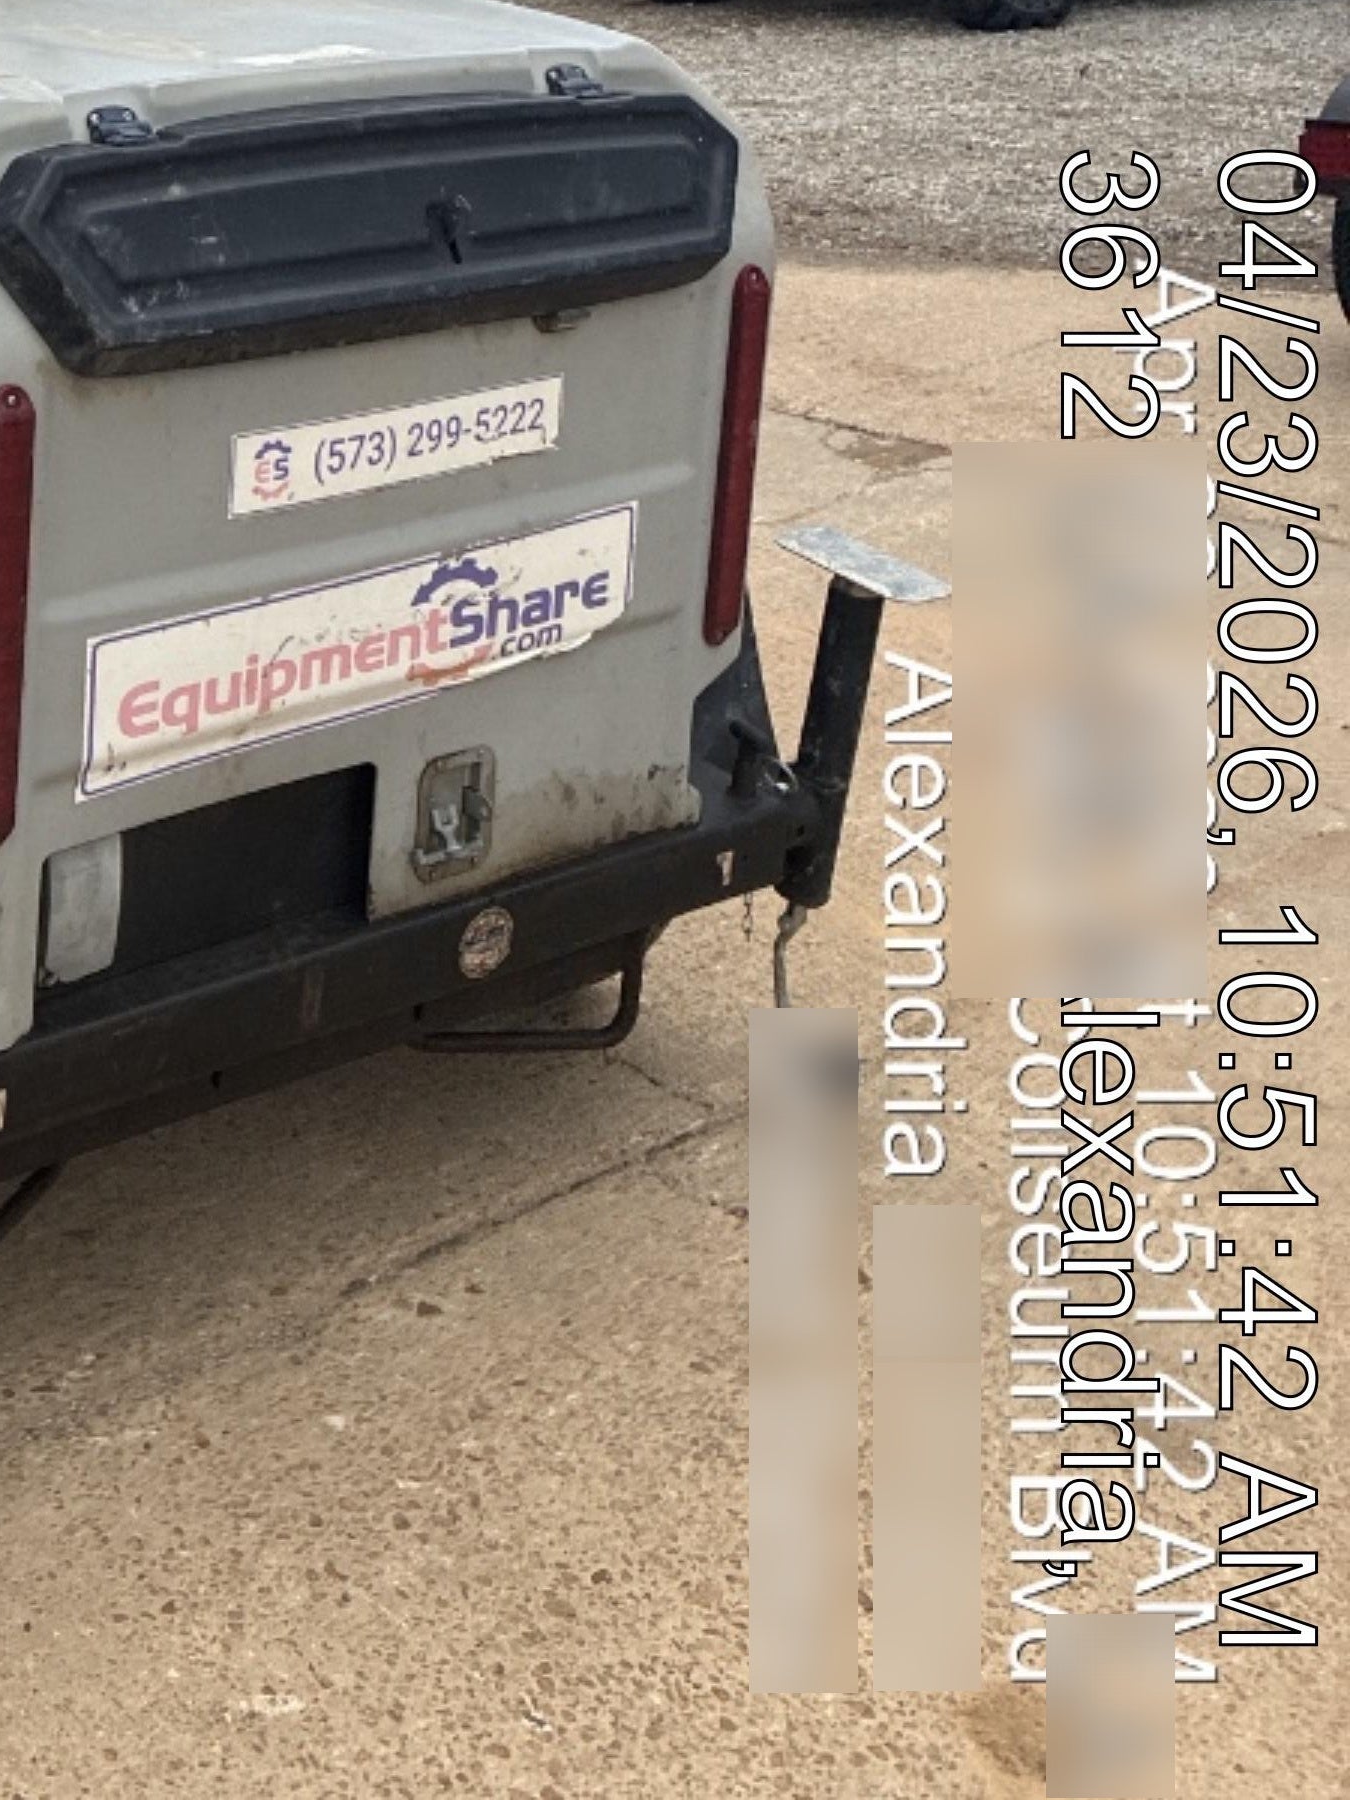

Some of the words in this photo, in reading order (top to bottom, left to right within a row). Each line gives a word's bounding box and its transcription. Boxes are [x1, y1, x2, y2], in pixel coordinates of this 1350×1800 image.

[312, 425, 398, 486] (573)
[406, 398, 546, 458] 299-5222
[117, 569, 611, 738] EquipmentShare
[491, 623, 563, 663] .com
